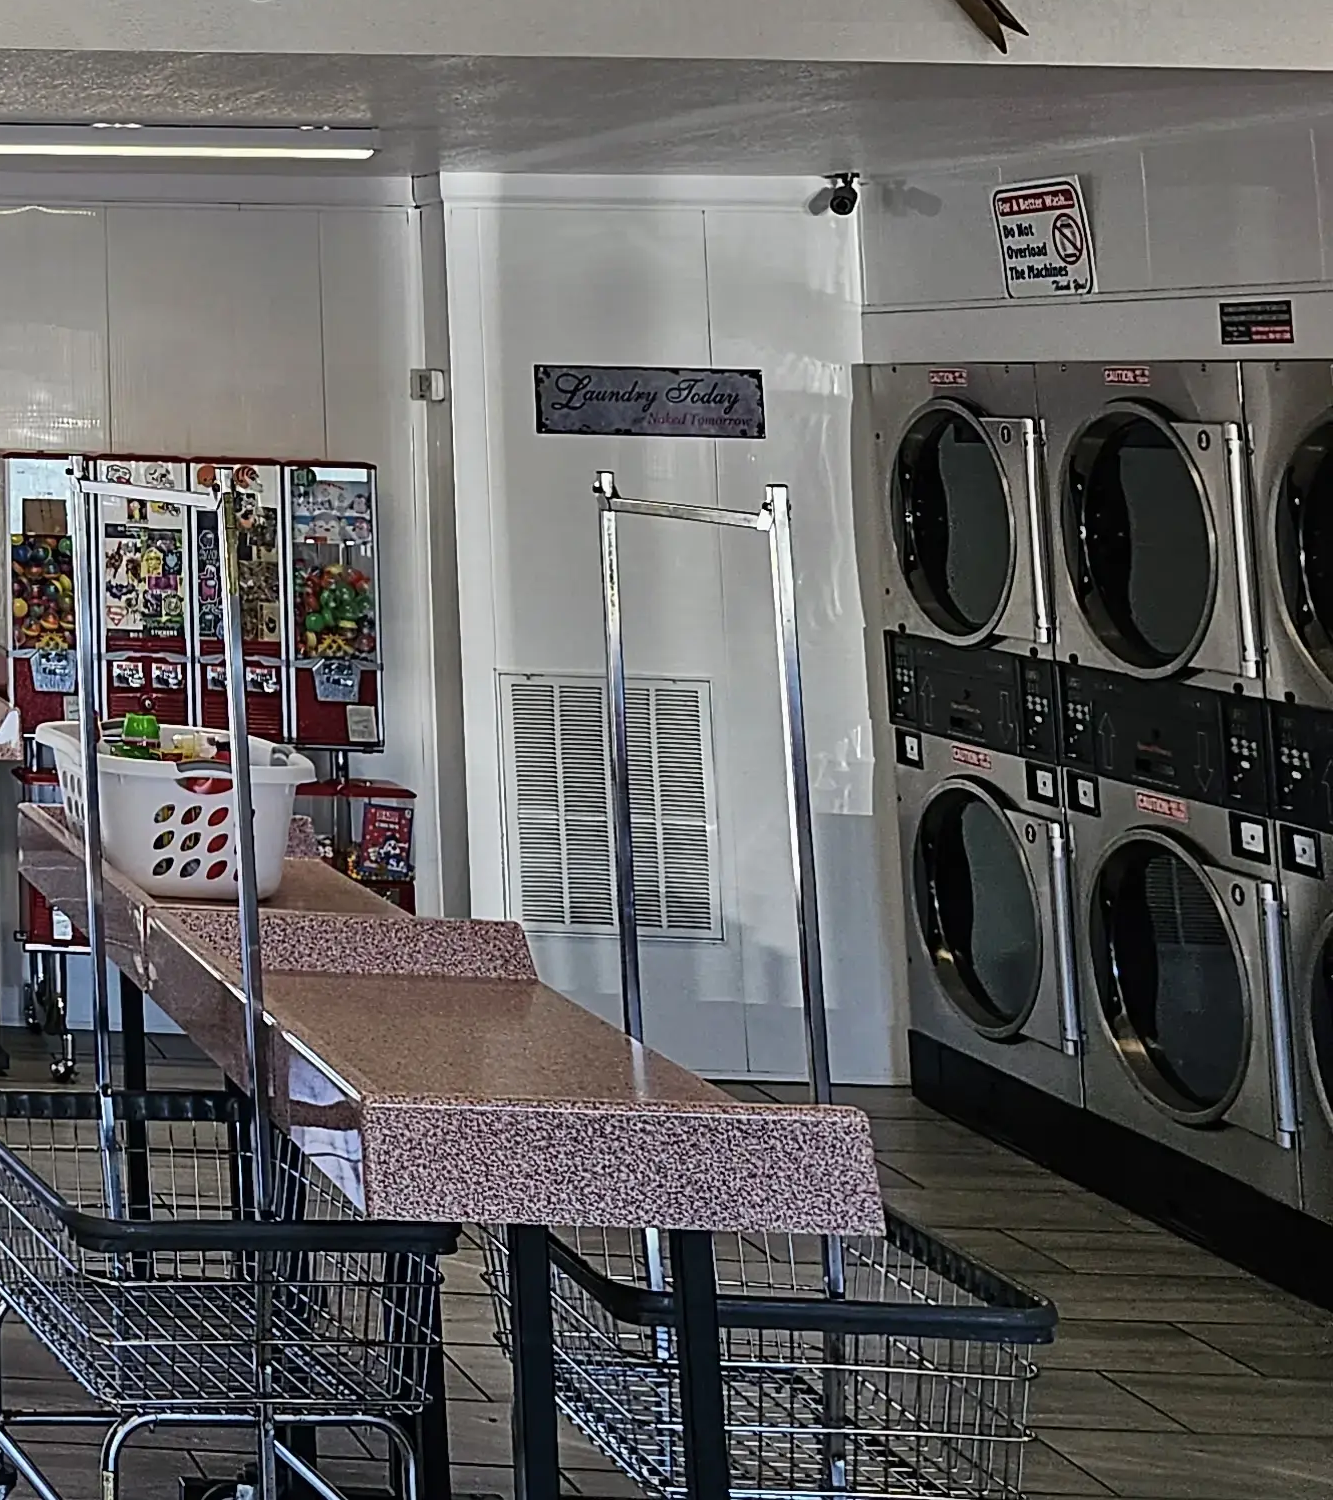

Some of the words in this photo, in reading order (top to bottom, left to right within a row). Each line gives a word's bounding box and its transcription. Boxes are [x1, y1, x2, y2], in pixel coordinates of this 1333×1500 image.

[997, 201, 1011, 213] For
[1012, 199, 1019, 211] A
[1019, 198, 1043, 211] Better
[1002, 224, 1015, 239] Do
[1016, 223, 1035, 238] Not
[1006, 242, 1048, 260] Overload
[1008, 266, 1026, 281] The
[1027, 262, 1068, 279] Machines
[551, 373, 658, 413] Laundry
[665, 378, 741, 415] Today
[648, 412, 688, 425] Naked
[690, 412, 753, 426] Tomorrow
